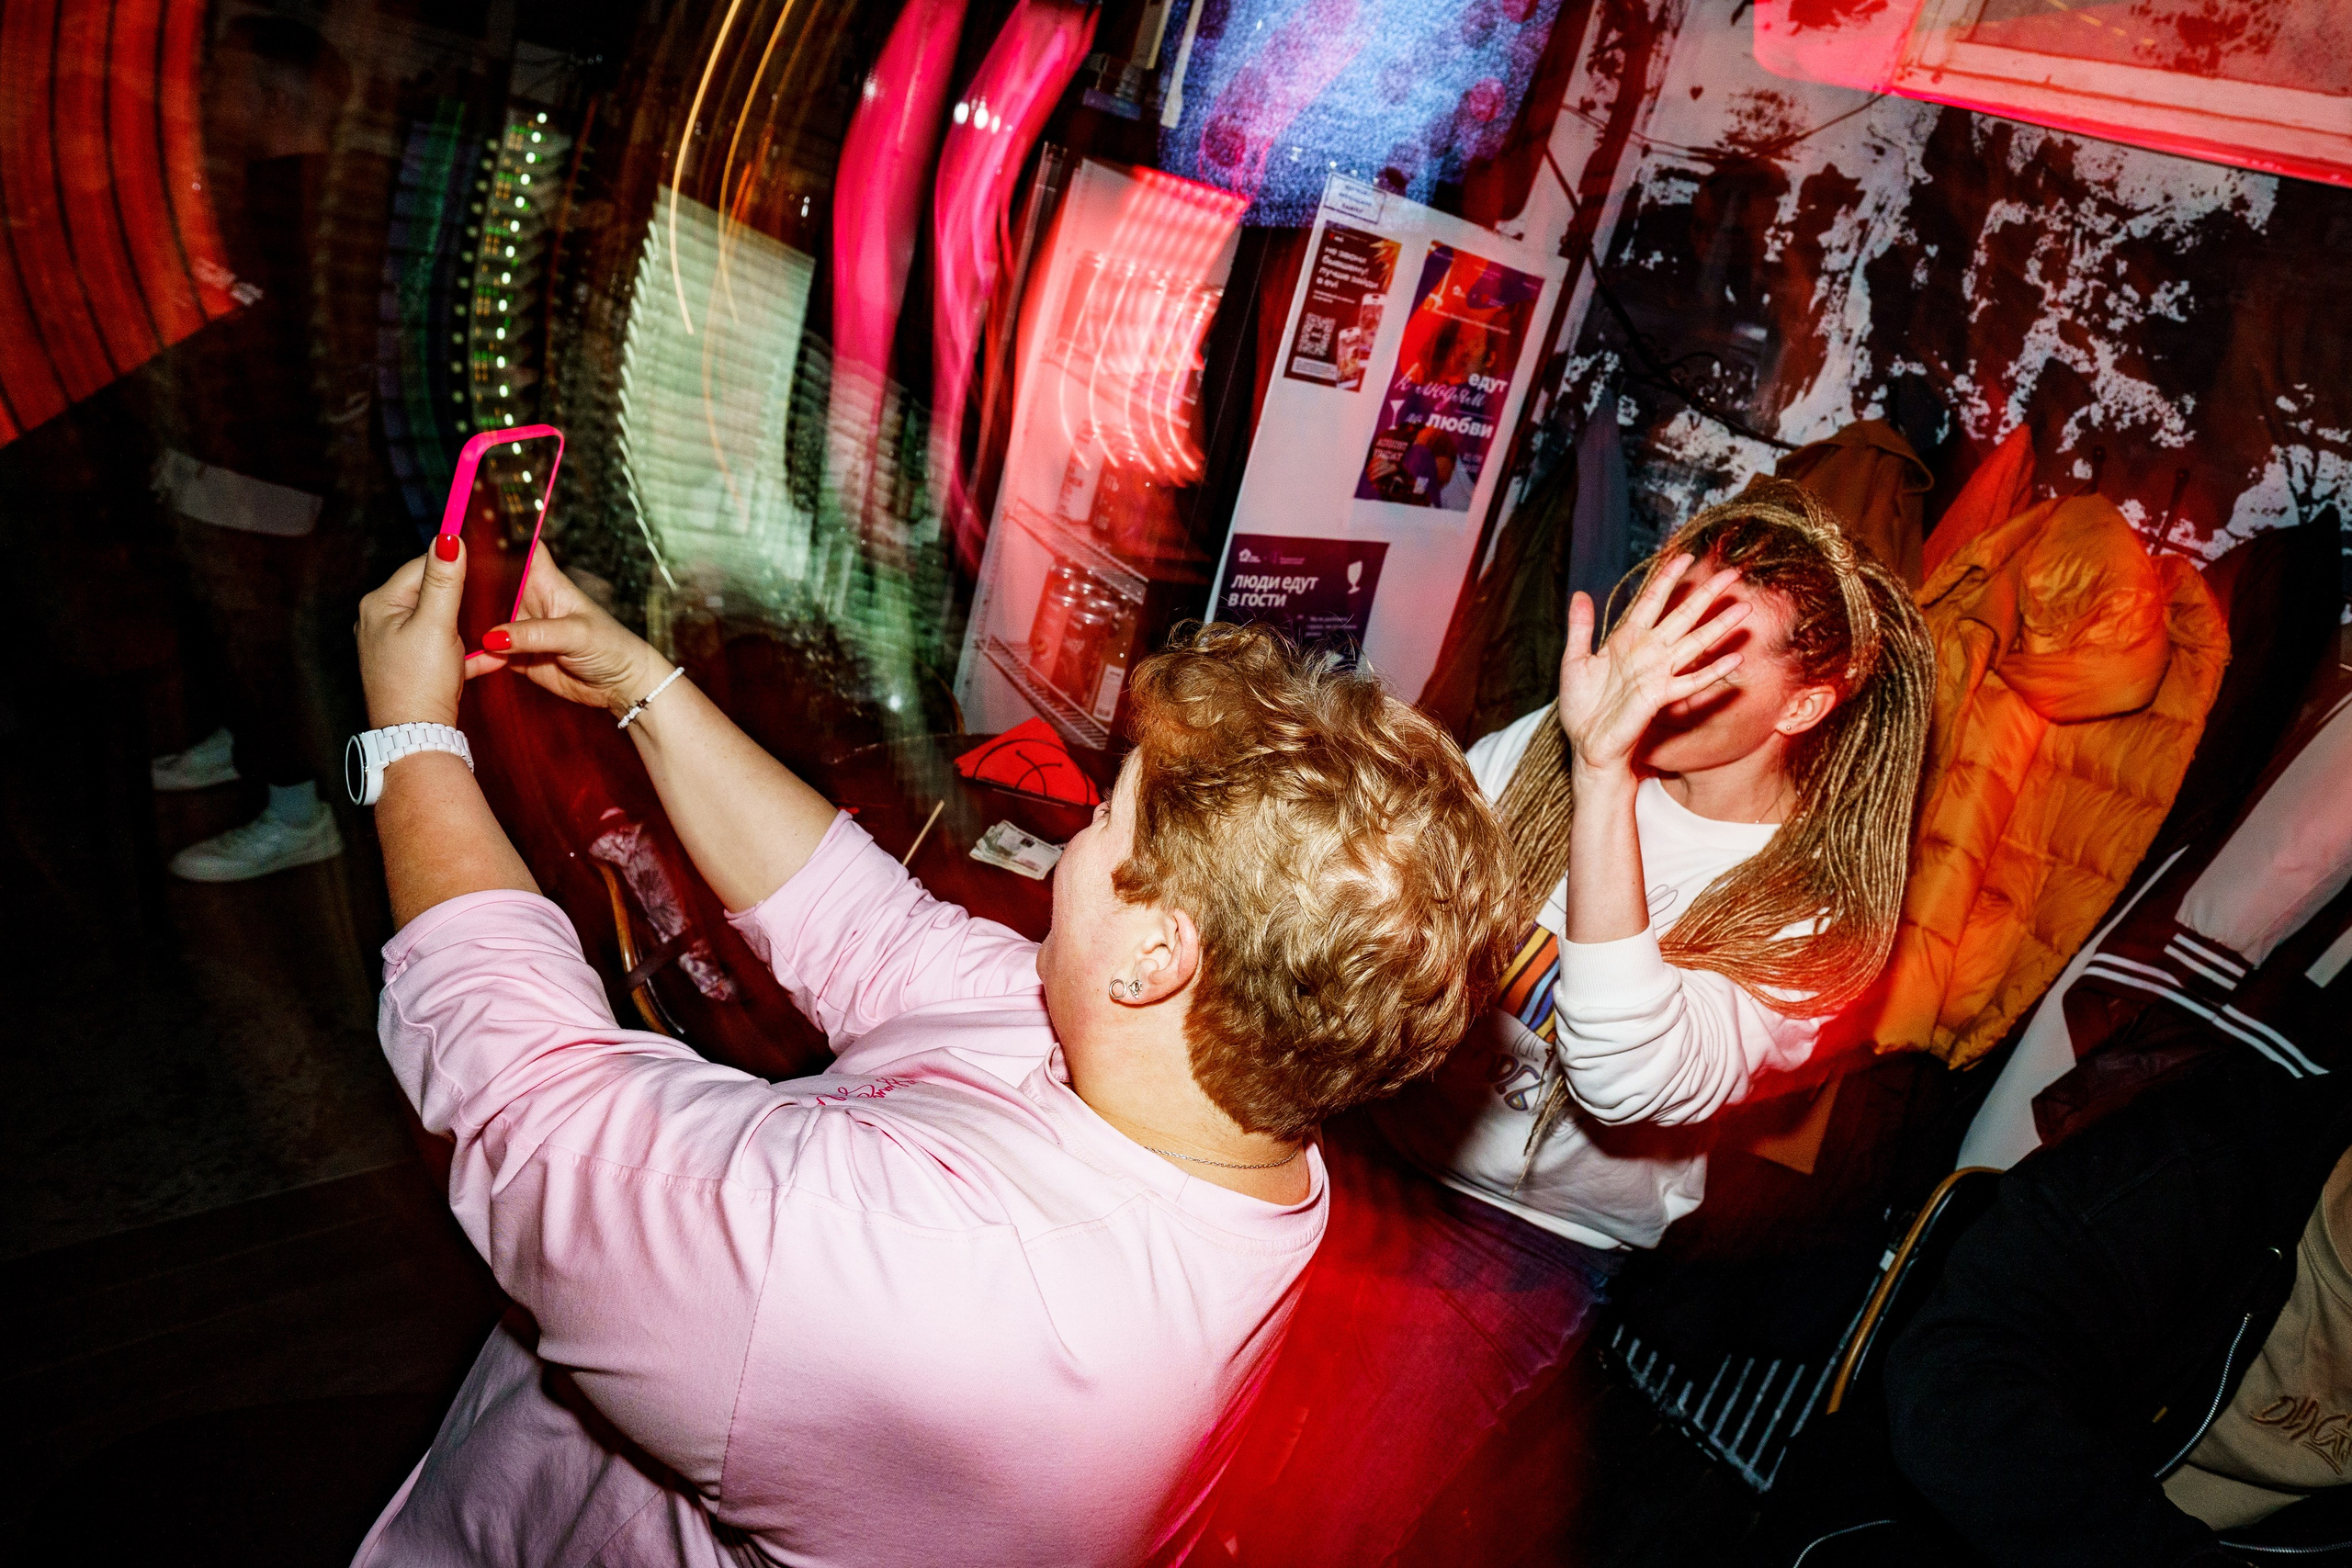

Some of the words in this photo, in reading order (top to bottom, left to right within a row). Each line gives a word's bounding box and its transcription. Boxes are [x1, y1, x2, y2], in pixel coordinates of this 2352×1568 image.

[1468, 373, 1509, 394] едут
[1425, 413, 1494, 439] любви
[1231, 574, 1282, 592] люди
[1282, 576, 1319, 595] едут
[1227, 593, 1238, 606] в
[1240, 593, 1287, 607] гости
